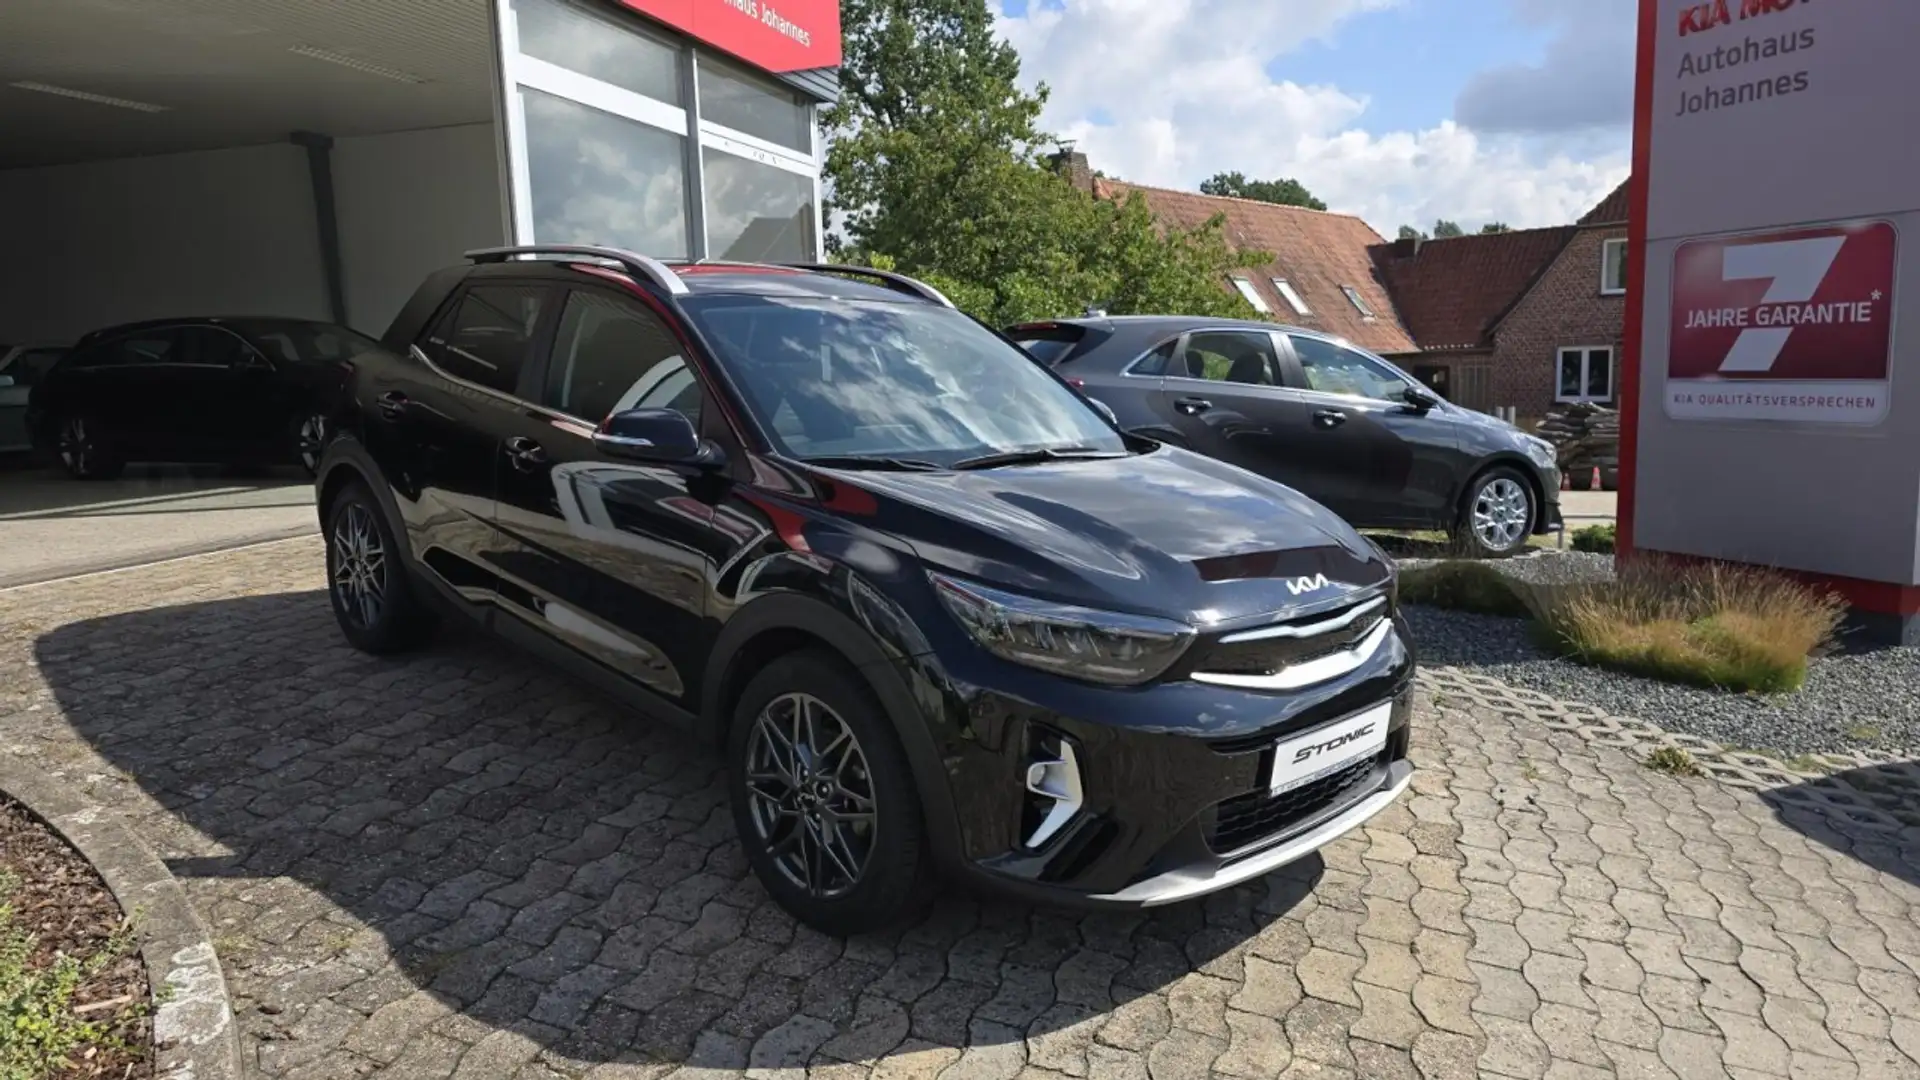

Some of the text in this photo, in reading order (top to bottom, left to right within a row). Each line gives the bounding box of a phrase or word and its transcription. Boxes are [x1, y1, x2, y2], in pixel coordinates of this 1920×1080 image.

[723, 0, 810, 48] aus Johannes
[1678, 0, 1731, 37] KIA
[1677, 28, 1815, 79] Autohaus
[1675, 71, 1809, 116] Johannes
[1684, 307, 1748, 328] JAHRE
[1674, 393, 1875, 409] KIA QUALITÄTSVERSPRECHEN
[1292, 722, 1376, 764] STONIC
